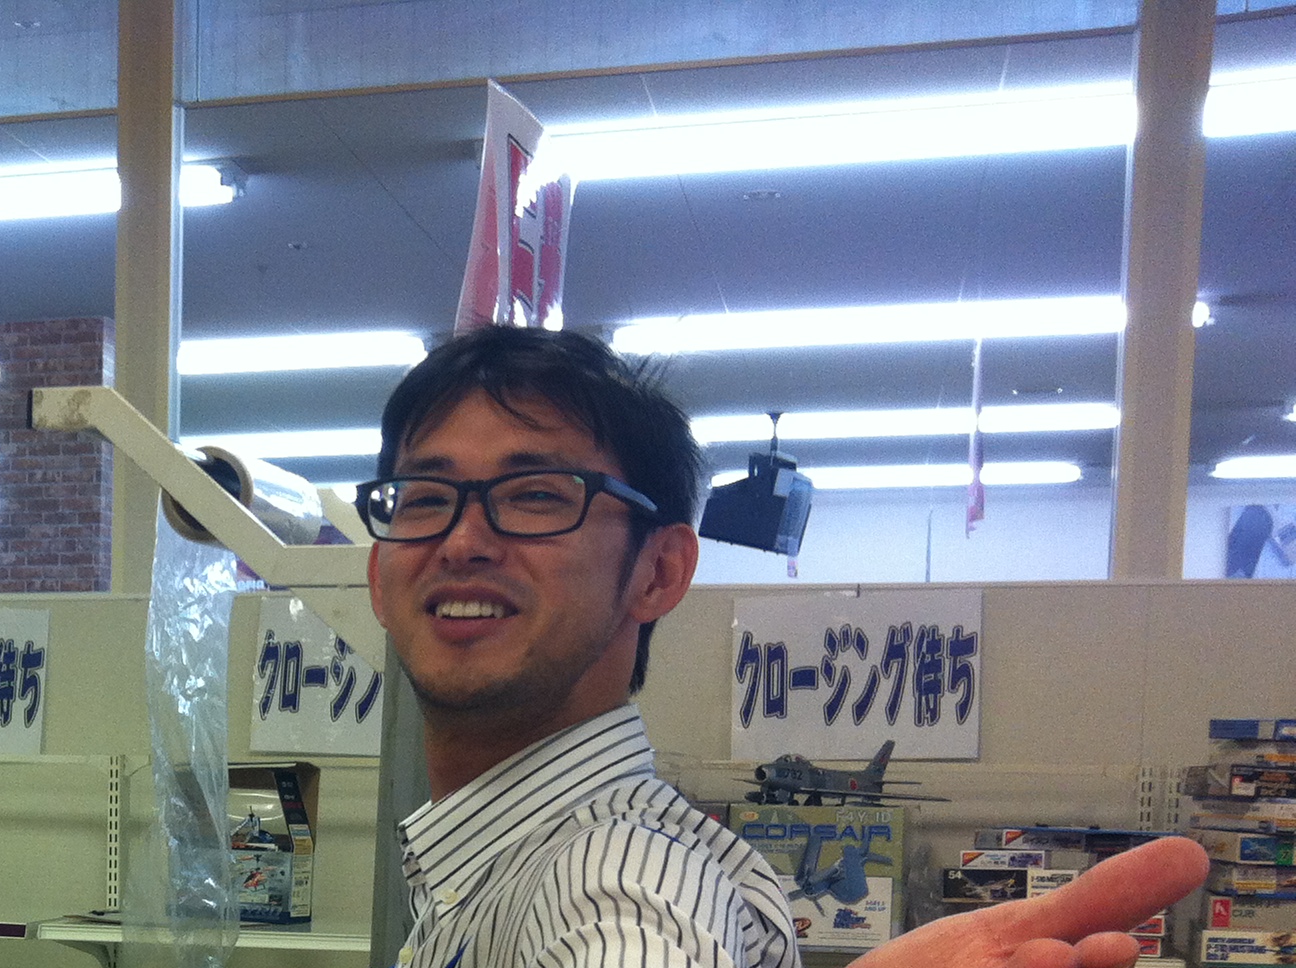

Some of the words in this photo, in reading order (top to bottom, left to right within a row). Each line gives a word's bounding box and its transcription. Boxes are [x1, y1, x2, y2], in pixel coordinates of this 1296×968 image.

[735, 622, 978, 728] クロージング待ち
[741, 823, 893, 842] CORSAIR
